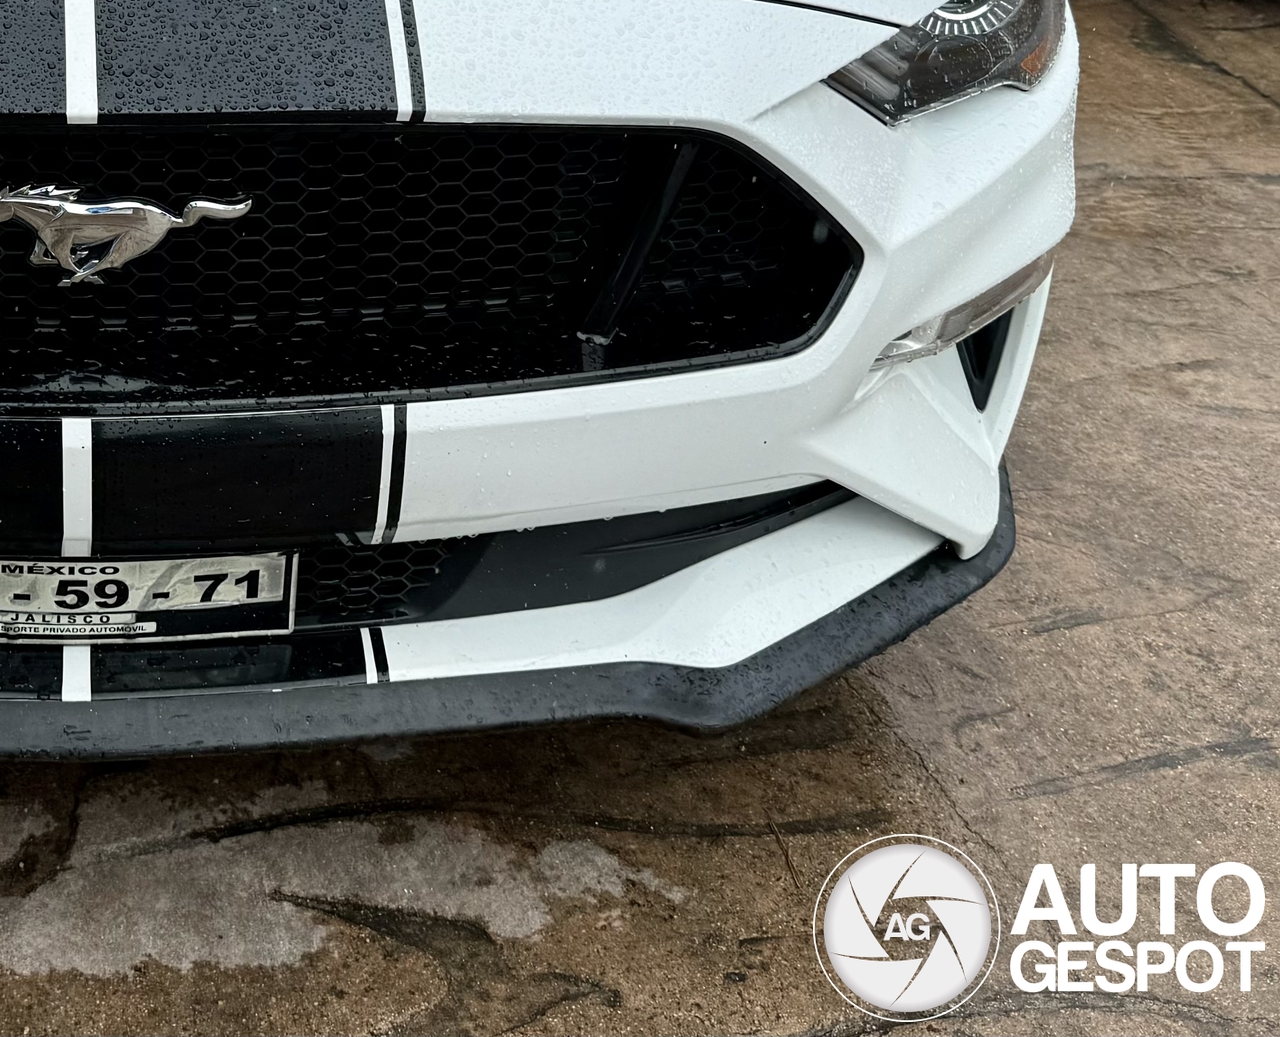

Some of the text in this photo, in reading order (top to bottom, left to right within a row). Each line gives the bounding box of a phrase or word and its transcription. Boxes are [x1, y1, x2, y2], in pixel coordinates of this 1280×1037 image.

[0, 563, 120, 577] MÉXICO
[54, 579, 130, 610] 59
[193, 569, 261, 603] 71
[10, 613, 111, 624] JALISCO
[42, 626, 87, 634] PRIVADO
